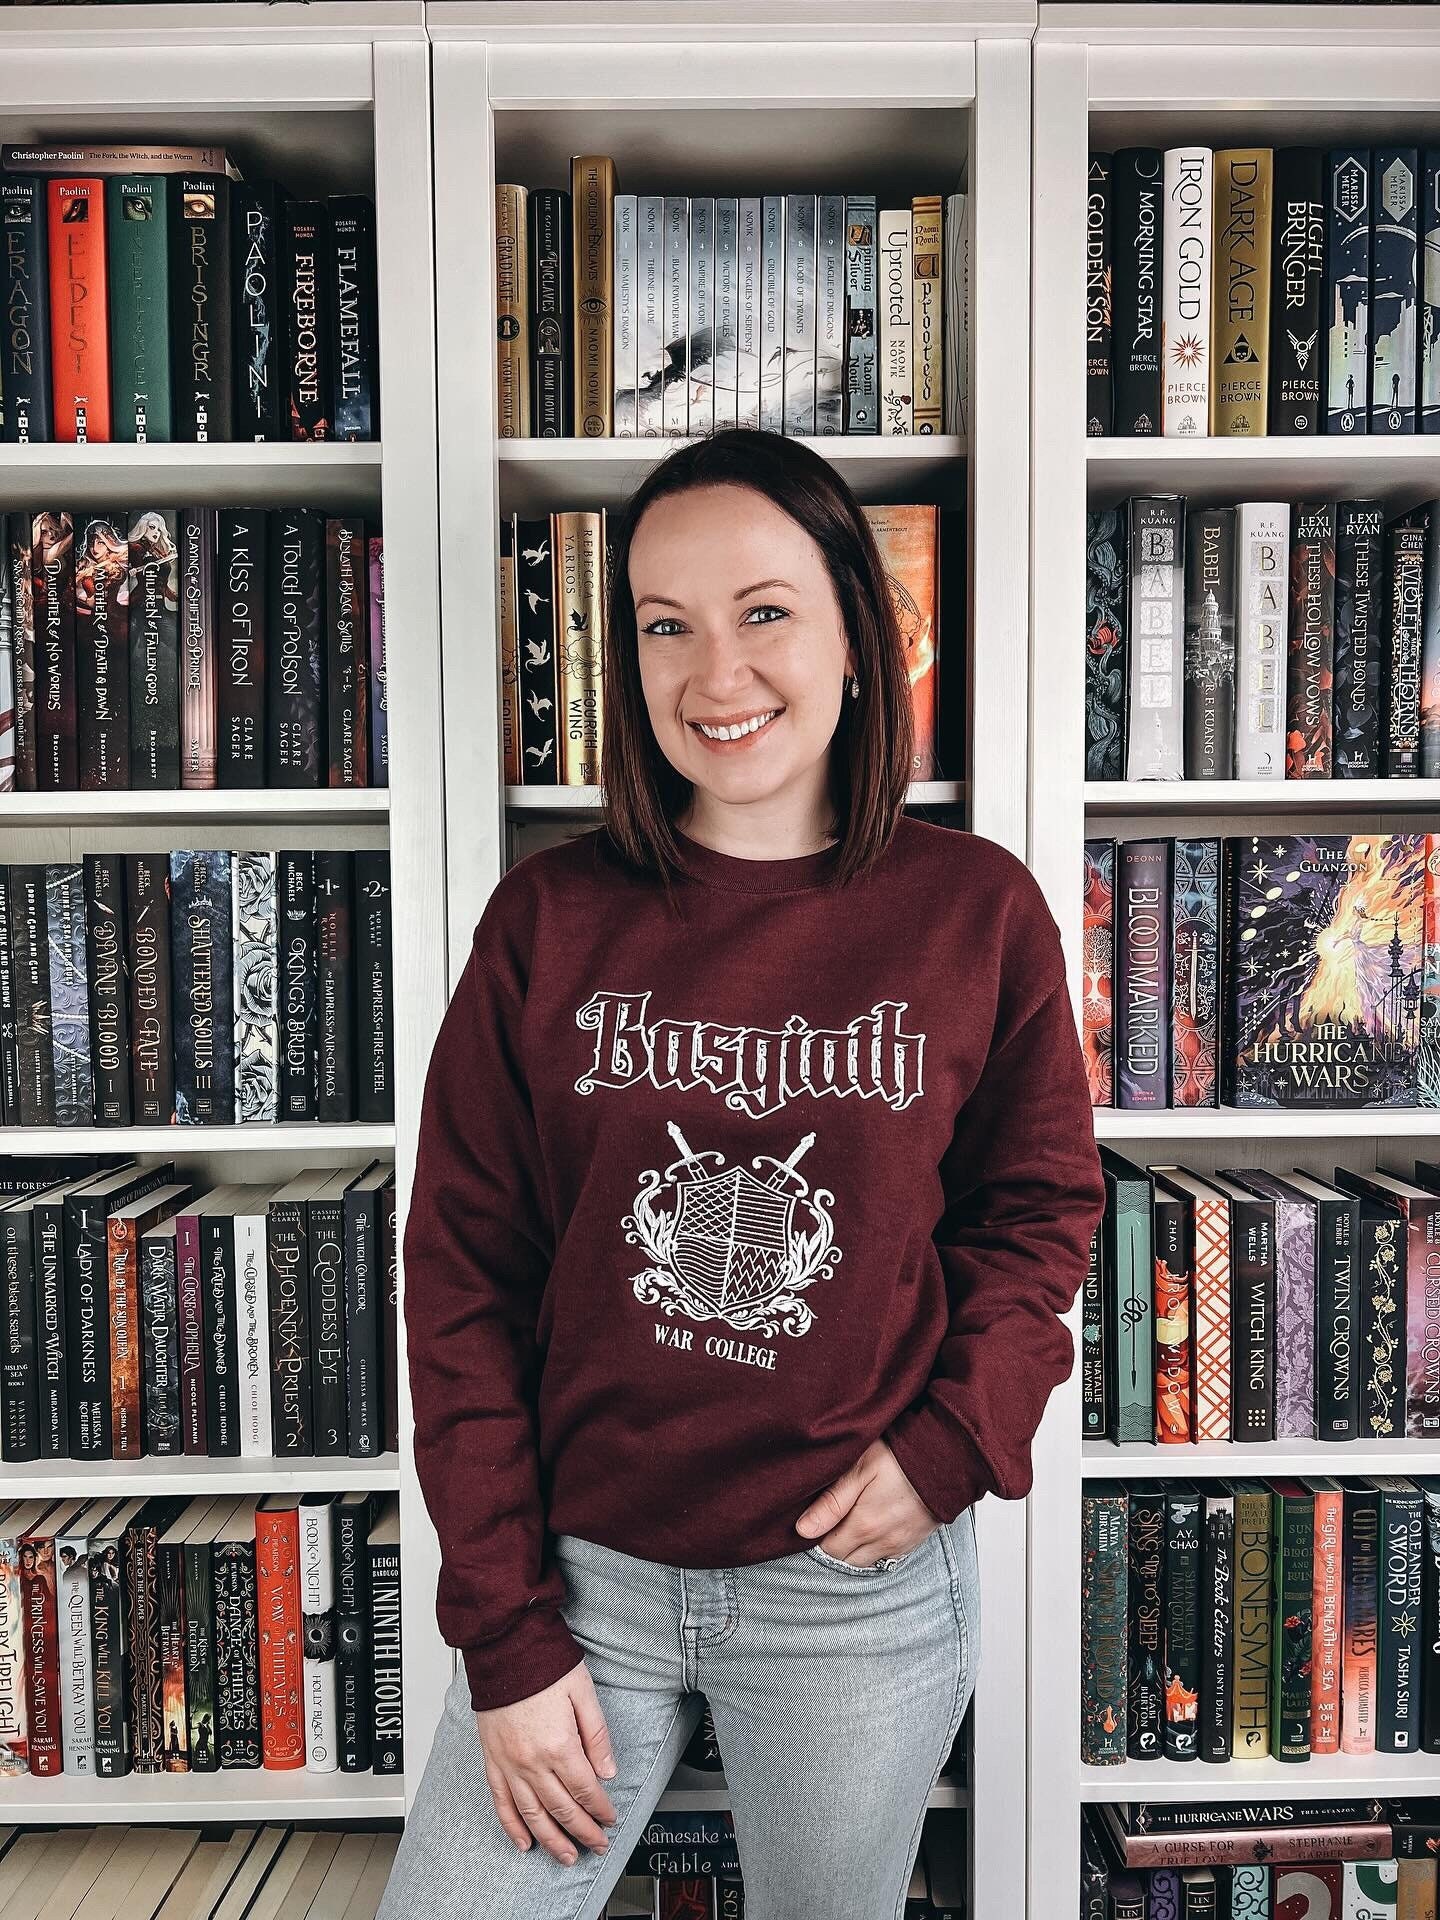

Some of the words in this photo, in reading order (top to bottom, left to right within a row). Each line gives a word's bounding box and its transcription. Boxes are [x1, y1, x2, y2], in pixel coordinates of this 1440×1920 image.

[11, 151, 56, 161] Christopher
[58, 151, 84, 160] Paolini
[89, 152, 102, 160] The
[104, 152, 118, 160] Fork,
[118, 152, 128, 160] the
[150, 152, 162, 160] and
[164, 152, 174, 161] the
[175, 153, 192, 161] Worm
[59, 186, 90, 196] Paolini
[122, 184, 152, 194] Paolini
[183, 181, 216, 192] Paolini
[1172, 156, 1204, 229] IRON
[1221, 159, 1258, 250] DARK
[1088, 194, 1105, 291] GOLDEN
[1134, 191, 1154, 290] MORNING
[497, 236, 515, 302] GRADUATE
[881, 228, 910, 328] Uprooted
[1178, 237, 1204, 320] GOLD
[1228, 259, 1258, 324] AGE
[1088, 295, 1102, 342] SON
[1132, 294, 1153, 350] STAR
[589, 329, 599, 368] NAOMI
[1131, 354, 1157, 362] PIERCE
[502, 357, 512, 390] NAOMI
[544, 360, 554, 390] NAOMI
[589, 371, 599, 408] NOVIK
[864, 352, 874, 396] Naomi
[1220, 381, 1261, 392] PIERCE
[1282, 380, 1320, 390] PIERCE
[502, 392, 512, 420] NOVIK
[544, 394, 555, 422] NOVIK
[1220, 392, 1261, 403] BROWN
[1282, 391, 1320, 402] BROWN
[232, 524, 248, 538] A
[284, 524, 298, 536] A
[1140, 516, 1176, 526] KUANG
[1298, 527, 1331, 539] RYAN
[1300, 516, 1330, 528] LEXI
[1346, 524, 1380, 536] RYAN
[1349, 514, 1378, 526] LEXI
[230, 548, 254, 593] KISS
[282, 541, 302, 596] TOUCH
[565, 535, 576, 595] YARROS
[584, 530, 594, 600] REBECCA
[1304, 542, 1321, 591] THESE
[1354, 538, 1370, 589] THESE
[232, 602, 252, 637] OF
[284, 602, 297, 626] OF
[1304, 593, 1321, 669] HOLLOW
[1354, 590, 1369, 658] TWISTED
[229, 640, 254, 686] IRON
[281, 626, 302, 695] POISON
[1304, 674, 1320, 726] VOWS
[1352, 659, 1368, 712] BONDS
[232, 716, 240, 760] SAGER
[244, 717, 254, 760] CLARE
[343, 708, 352, 748] CLARE
[569, 698, 583, 740] WING
[584, 690, 598, 750] FOURTH
[292, 722, 301, 766] CLARE
[344, 748, 352, 782] SAGER
[1126, 854, 1162, 864] DEONN
[1300, 860, 1368, 873] GUANZON
[1316, 848, 1352, 860] THEA
[288, 860, 296, 902] MICHAELS
[296, 872, 304, 892] BECK
[93, 920, 119, 996] DIVINE
[134, 926, 158, 1011] BONDED
[188, 914, 214, 1012] SHATTERED
[372, 970, 383, 1024] EMPRESS
[1128, 887, 1162, 1076] BLOODMARKED
[98, 1002, 120, 1070] BLOOD
[139, 1017, 160, 1071] FATE
[190, 1014, 214, 1070] SOULS
[373, 1030, 384, 1057] FIRE
[1314, 1024, 1348, 1040] THE
[1252, 1042, 1404, 1064] HURRICANE
[374, 1060, 384, 1094] STEEL
[1290, 1064, 1370, 1094] WARS
[41, 1223, 57, 1253] THE
[316, 1230, 337, 1239] THE
[1168, 1220, 1177, 1252] ZHAO
[1248, 1228, 1256, 1262] WELLS
[1260, 1222, 1268, 1266] MARTHA
[77, 1242, 93, 1281] LADY
[148, 1246, 166, 1285] DARK
[42, 1254, 60, 1330] UNMARKED
[80, 1282, 93, 1308] OF
[314, 1242, 342, 1341] GODDESS
[1334, 1254, 1350, 1310] TWIN
[1424, 1252, 1440, 1320] CURSED
[148, 1285, 168, 1325] WATER
[1250, 1282, 1266, 1341] WITCH
[48, 1332, 64, 1381] WITCH
[81, 1308, 96, 1384] DARKNESS
[151, 1326, 169, 1388] DAUGHTER
[654, 1324, 694, 1352] WAR
[704, 1335, 778, 1371] COLLEGE
[1330, 1315, 1350, 1400] CROWNS
[1422, 1324, 1440, 1404] CROWNS
[319, 1348, 342, 1385] EYE
[1250, 1349, 1265, 1390] KING
[50, 1388, 58, 1431] MIRANDA
[1170, 1540, 1199, 1550] CHAO
[1176, 1530, 1194, 1538] A.Y.
[372, 1557, 398, 1568] LEIGH
[1217, 1548, 1226, 1566] The
[1387, 1523, 1408, 1606] SWORD
[1408, 1520, 1422, 1608] OLEANDER
[1214, 1566, 1230, 1606] Book
[93, 1605, 110, 1645] KING
[372, 1590, 401, 1660] NINTH
[1214, 1610, 1228, 1658] Eaters
[1240, 1530, 1270, 1730] BONESMITH
[96, 1644, 109, 1668] WILL
[162, 1624, 171, 1668] BETRAYAL
[188, 1620, 199, 1672] DECEPTION
[1396, 1644, 1410, 1688] TASHA
[95, 1669, 110, 1700] KILL
[312, 1674, 322, 1707] HOLLY
[344, 1674, 354, 1708] HOLLY
[1216, 1664, 1225, 1695] SUNYI
[96, 1704, 112, 1734] YOU
[374, 1668, 402, 1741] HOUSE
[1140, 1686, 1148, 1727] BURTON
[1216, 1698, 1224, 1727] DEAN
[1320, 1713, 1332, 1721] OH
[1395, 1690, 1410, 1720] SURI
[311, 1710, 323, 1741] BLACK
[344, 1710, 356, 1744] BLACK
[638, 1824, 720, 1846] Namesake
[1174, 1811, 1242, 1824] HURRICANE
[1242, 1806, 1294, 1822] WARS
[1290, 1836, 1353, 1848] STEPHANIE
[1298, 1850, 1345, 1860] GARBER
[650, 1852, 712, 1874] Fable
